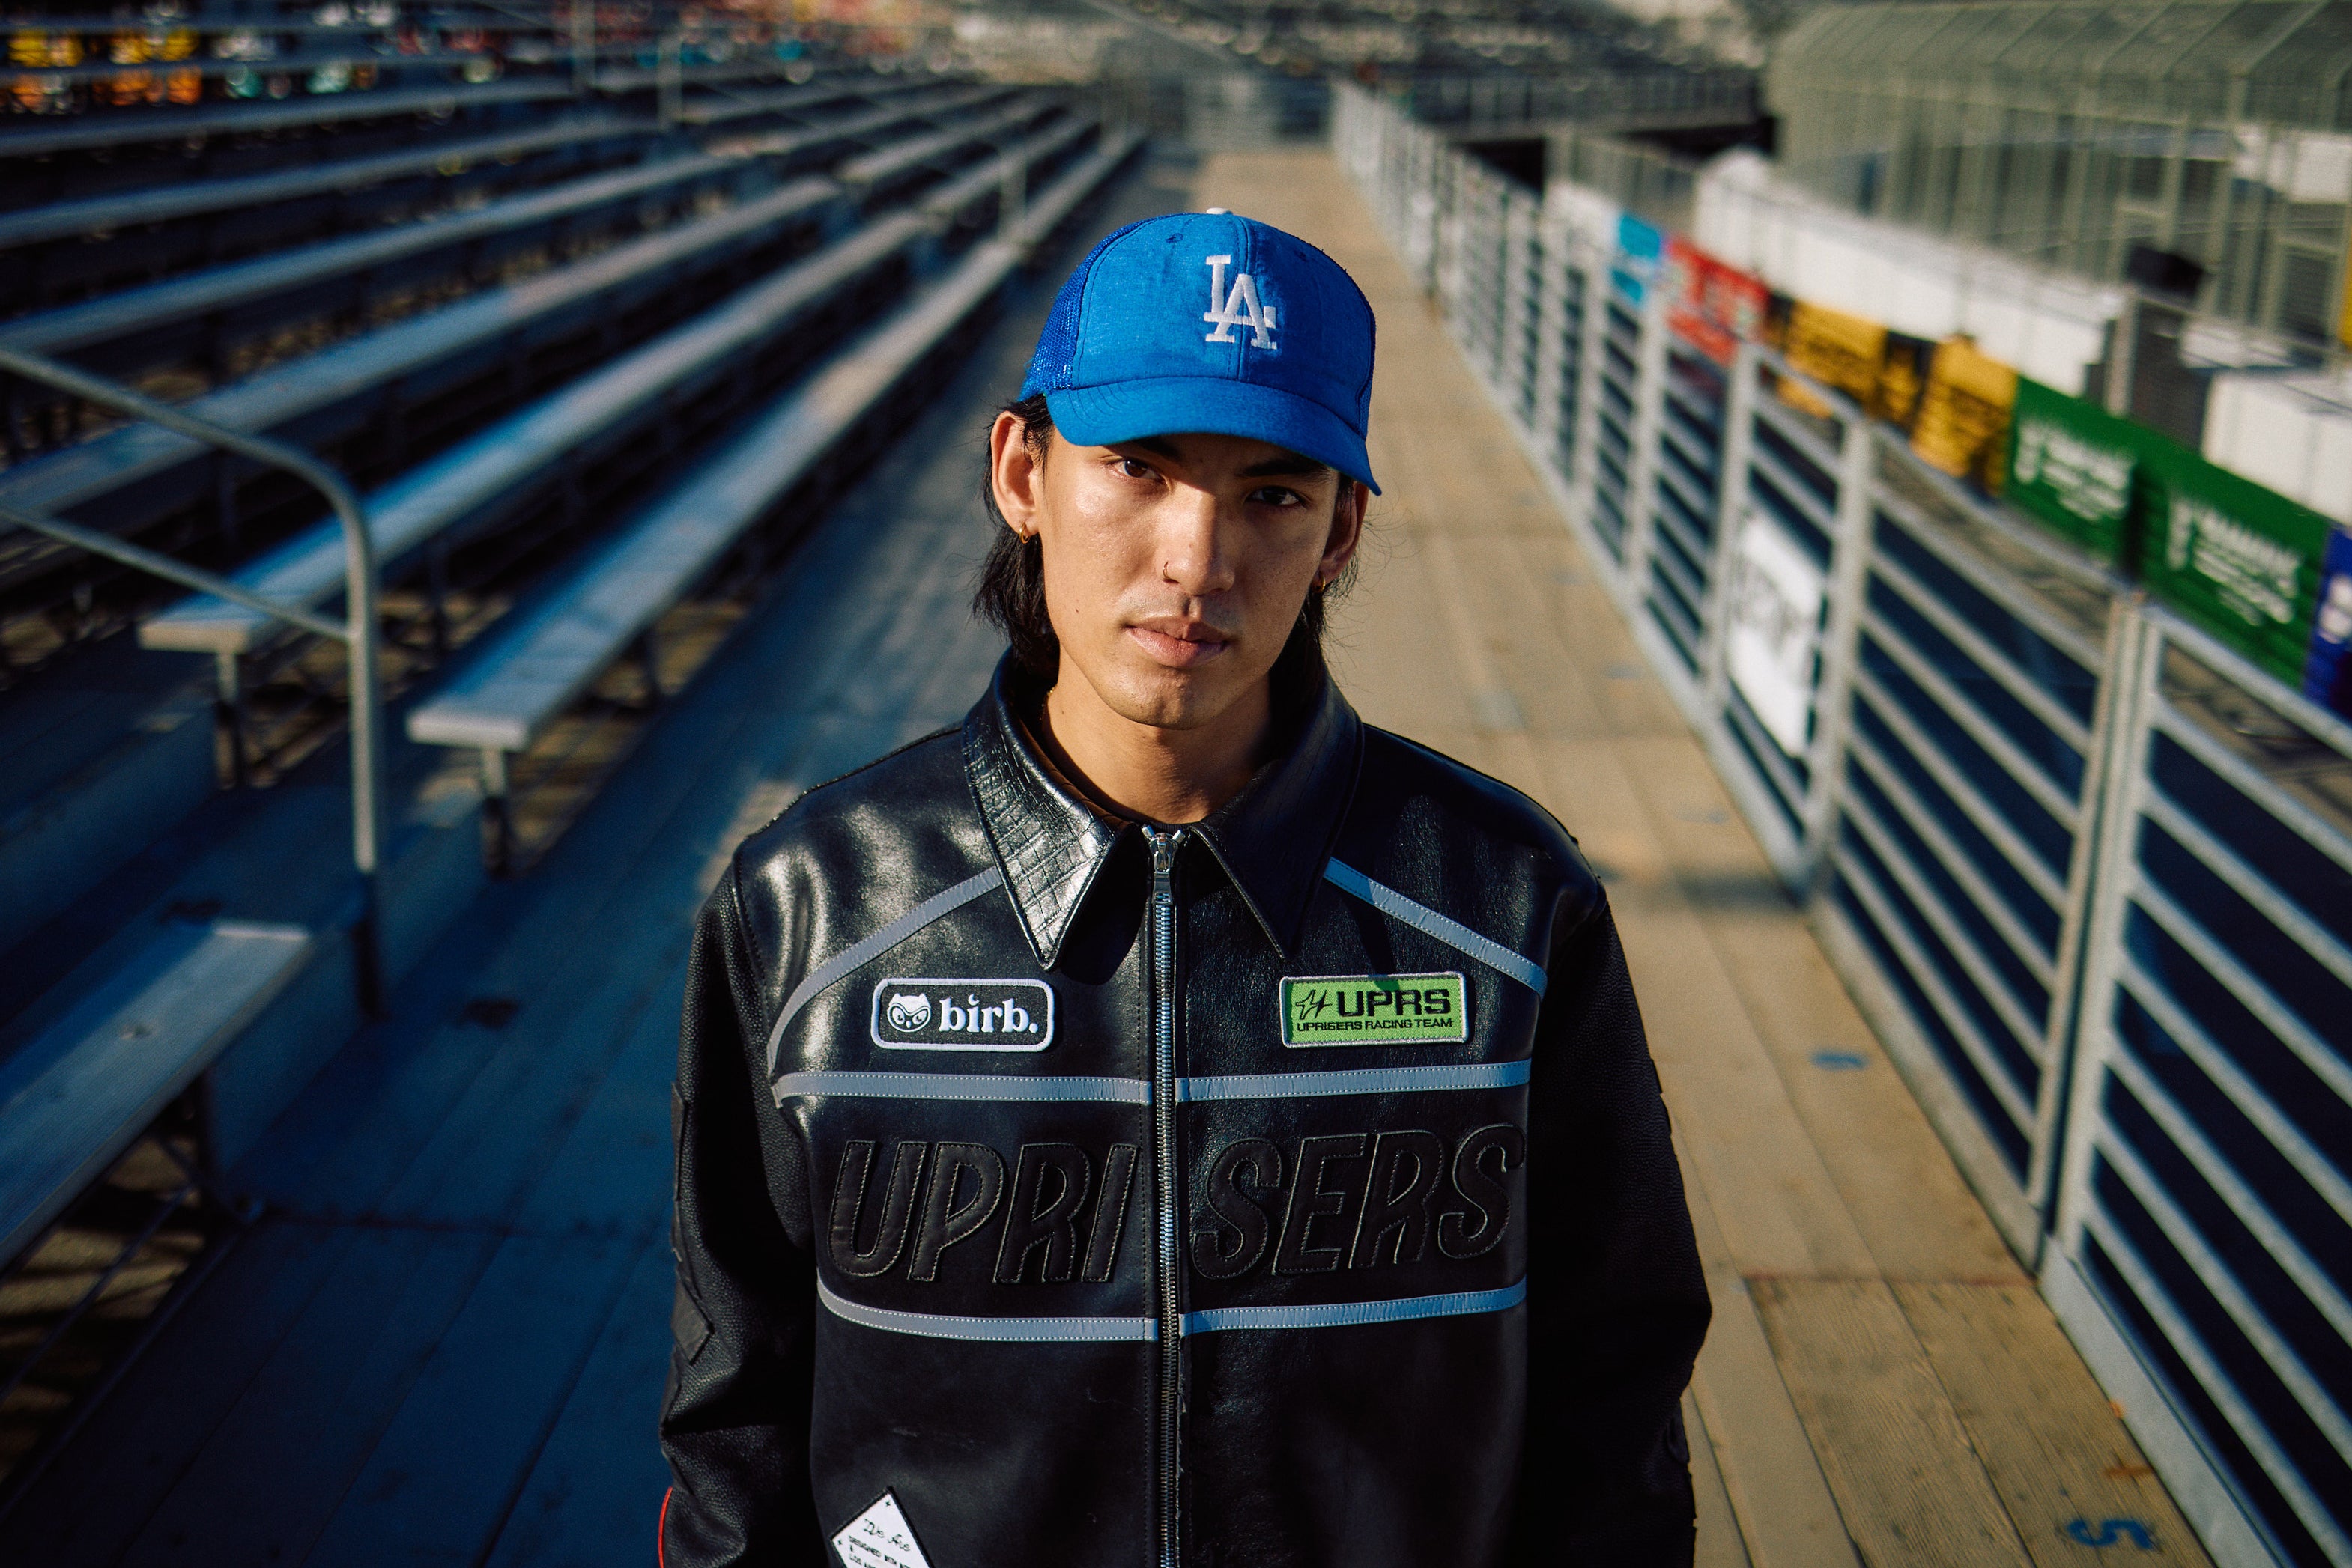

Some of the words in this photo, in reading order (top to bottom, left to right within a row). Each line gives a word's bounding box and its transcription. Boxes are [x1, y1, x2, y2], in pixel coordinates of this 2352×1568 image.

[1203, 254, 1278, 350] LA
[938, 994, 1040, 1033] birb.
[1336, 988, 1452, 1018] UPRS
[1297, 1020, 1363, 1032] UPRISERS
[1365, 1018, 1413, 1030] RACING
[1415, 1017, 1455, 1028] TEAM
